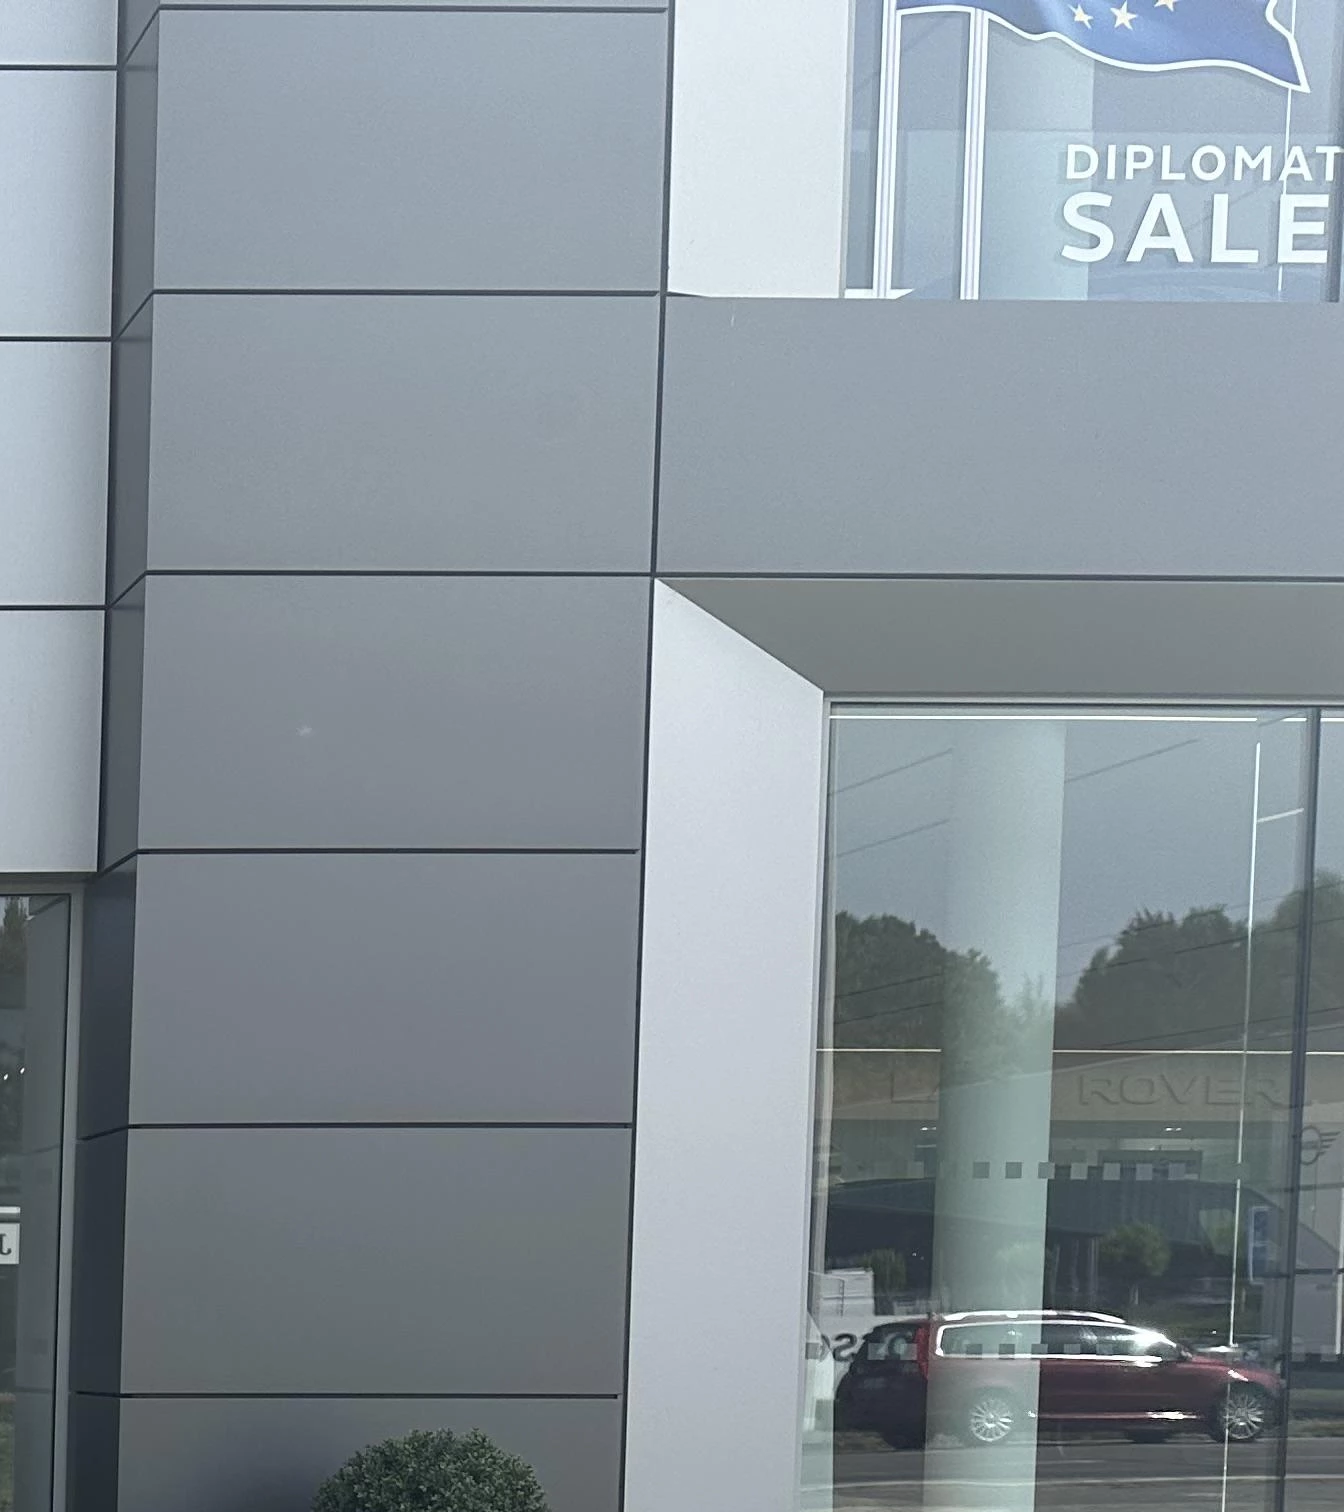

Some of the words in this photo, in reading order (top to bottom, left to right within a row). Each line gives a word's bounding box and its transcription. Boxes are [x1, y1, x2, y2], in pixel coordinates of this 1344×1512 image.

[1065, 143, 1344, 182] DIPLOMAT
[1060, 191, 1329, 264] SALE
[1077, 1073, 1292, 1107] ROVER
